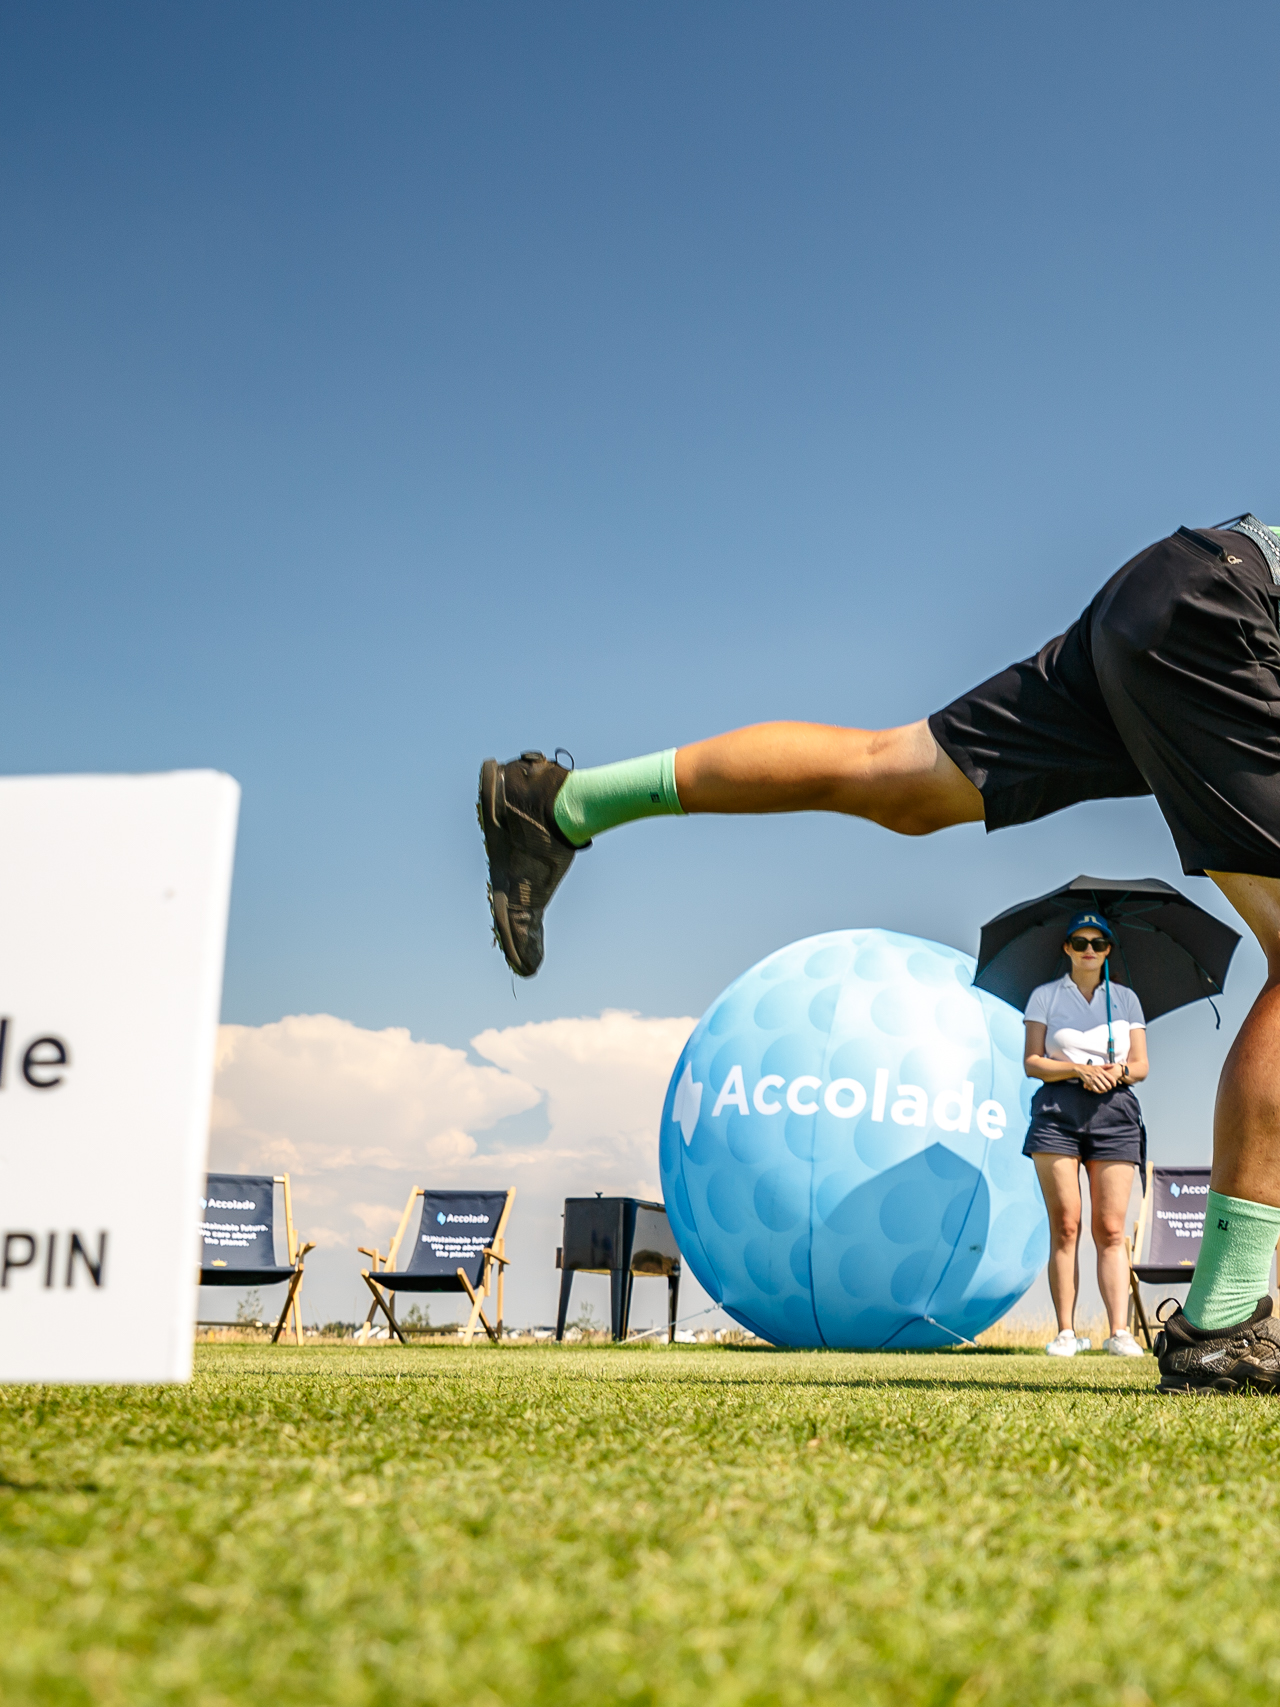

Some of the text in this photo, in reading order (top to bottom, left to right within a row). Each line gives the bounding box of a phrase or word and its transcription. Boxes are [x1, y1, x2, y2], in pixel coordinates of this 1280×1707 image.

[711, 1064, 1007, 1140] Accolade
[208, 1198, 256, 1210] Accolade
[447, 1213, 489, 1223] Accolade
[1168, 1220, 1183, 1229] We
[212, 1231, 231, 1239] care
[231, 1232, 257, 1240] about
[1175, 1229, 1190, 1238] the
[204, 1237, 219, 1245] the
[430, 1243, 444, 1251] We
[435, 1250, 449, 1258] the
[0, 1231, 107, 1289] PIN
